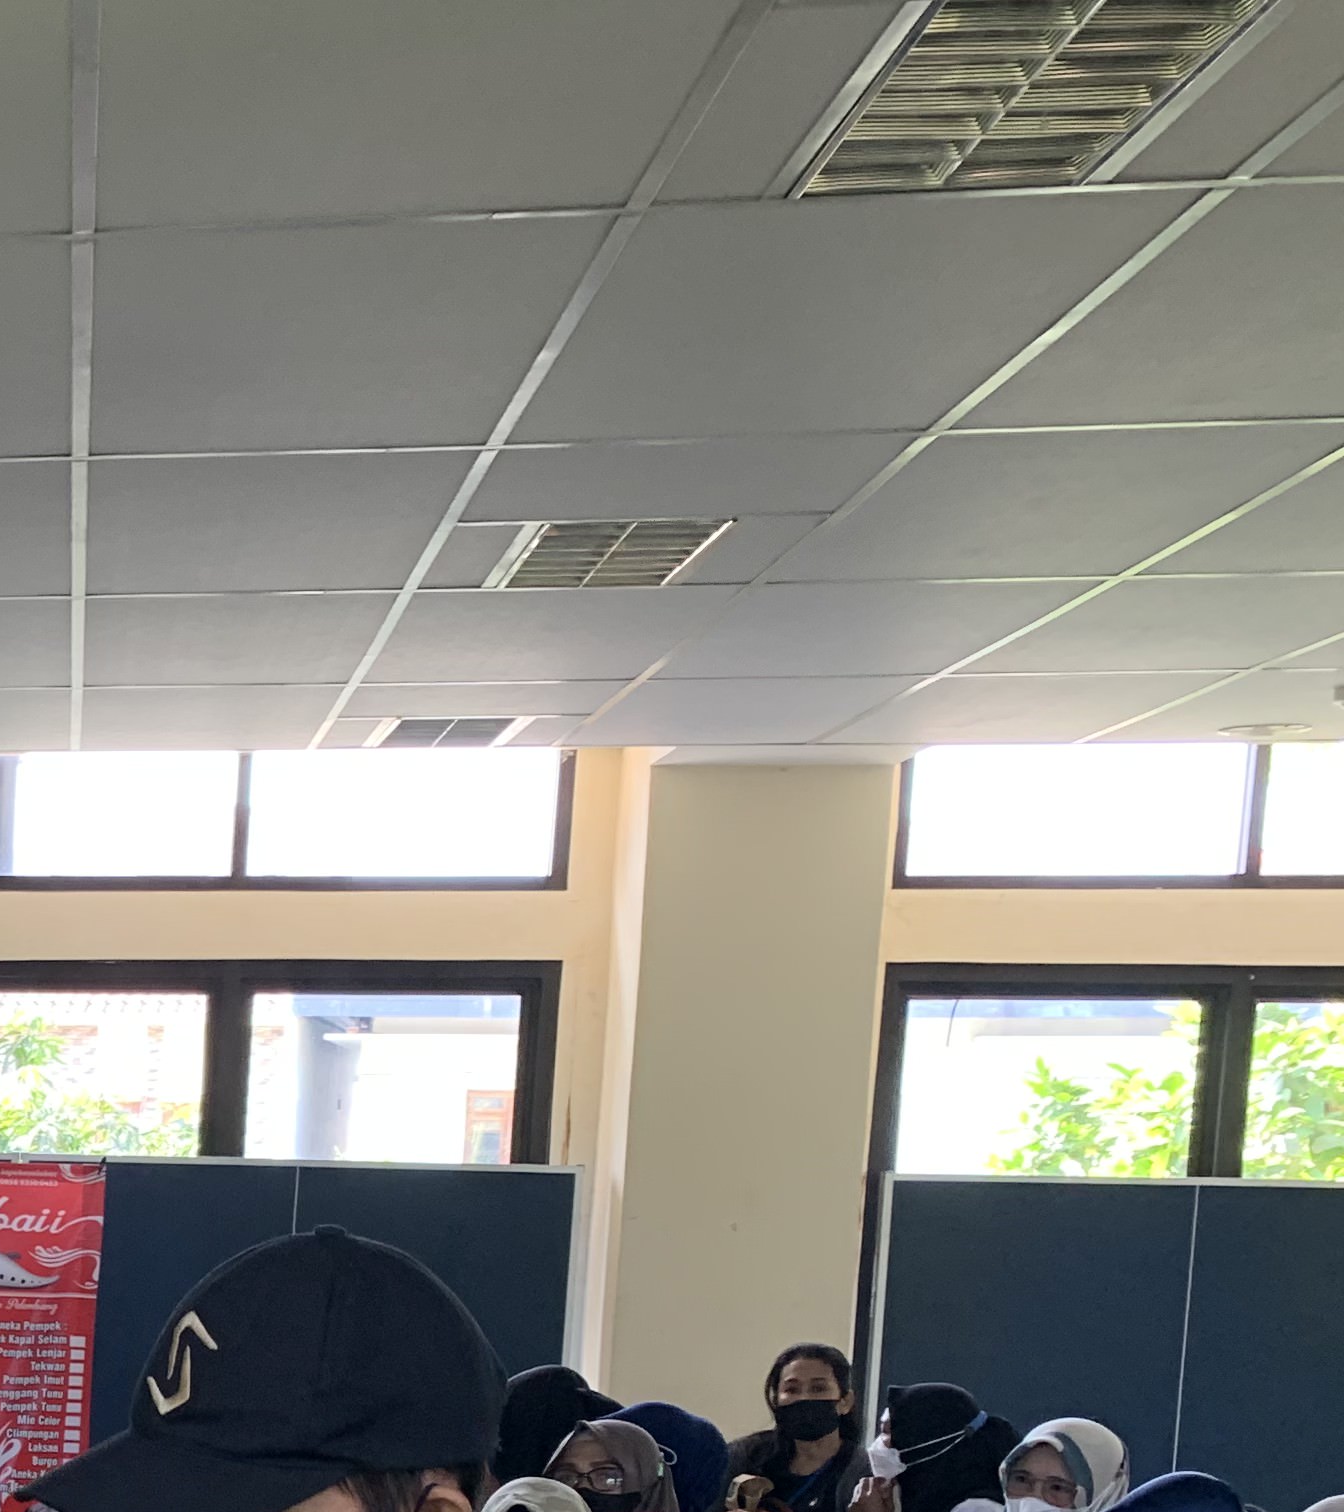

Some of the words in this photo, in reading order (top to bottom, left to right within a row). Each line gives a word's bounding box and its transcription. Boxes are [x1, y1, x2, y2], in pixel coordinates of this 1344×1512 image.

[23, 1321, 61, 1332] Pempek
[8, 1333, 35, 1346] Kapal
[38, 1335, 67, 1345] Selam
[36, 1348, 66, 1360] Lenjar
[31, 1361, 65, 1371] Tekwan
[3, 1374, 41, 1386] Pempek
[0, 1401, 38, 1412] Pempek
[17, 1415, 35, 1425] Mie
[32, 1456, 58, 1468] Burgo
